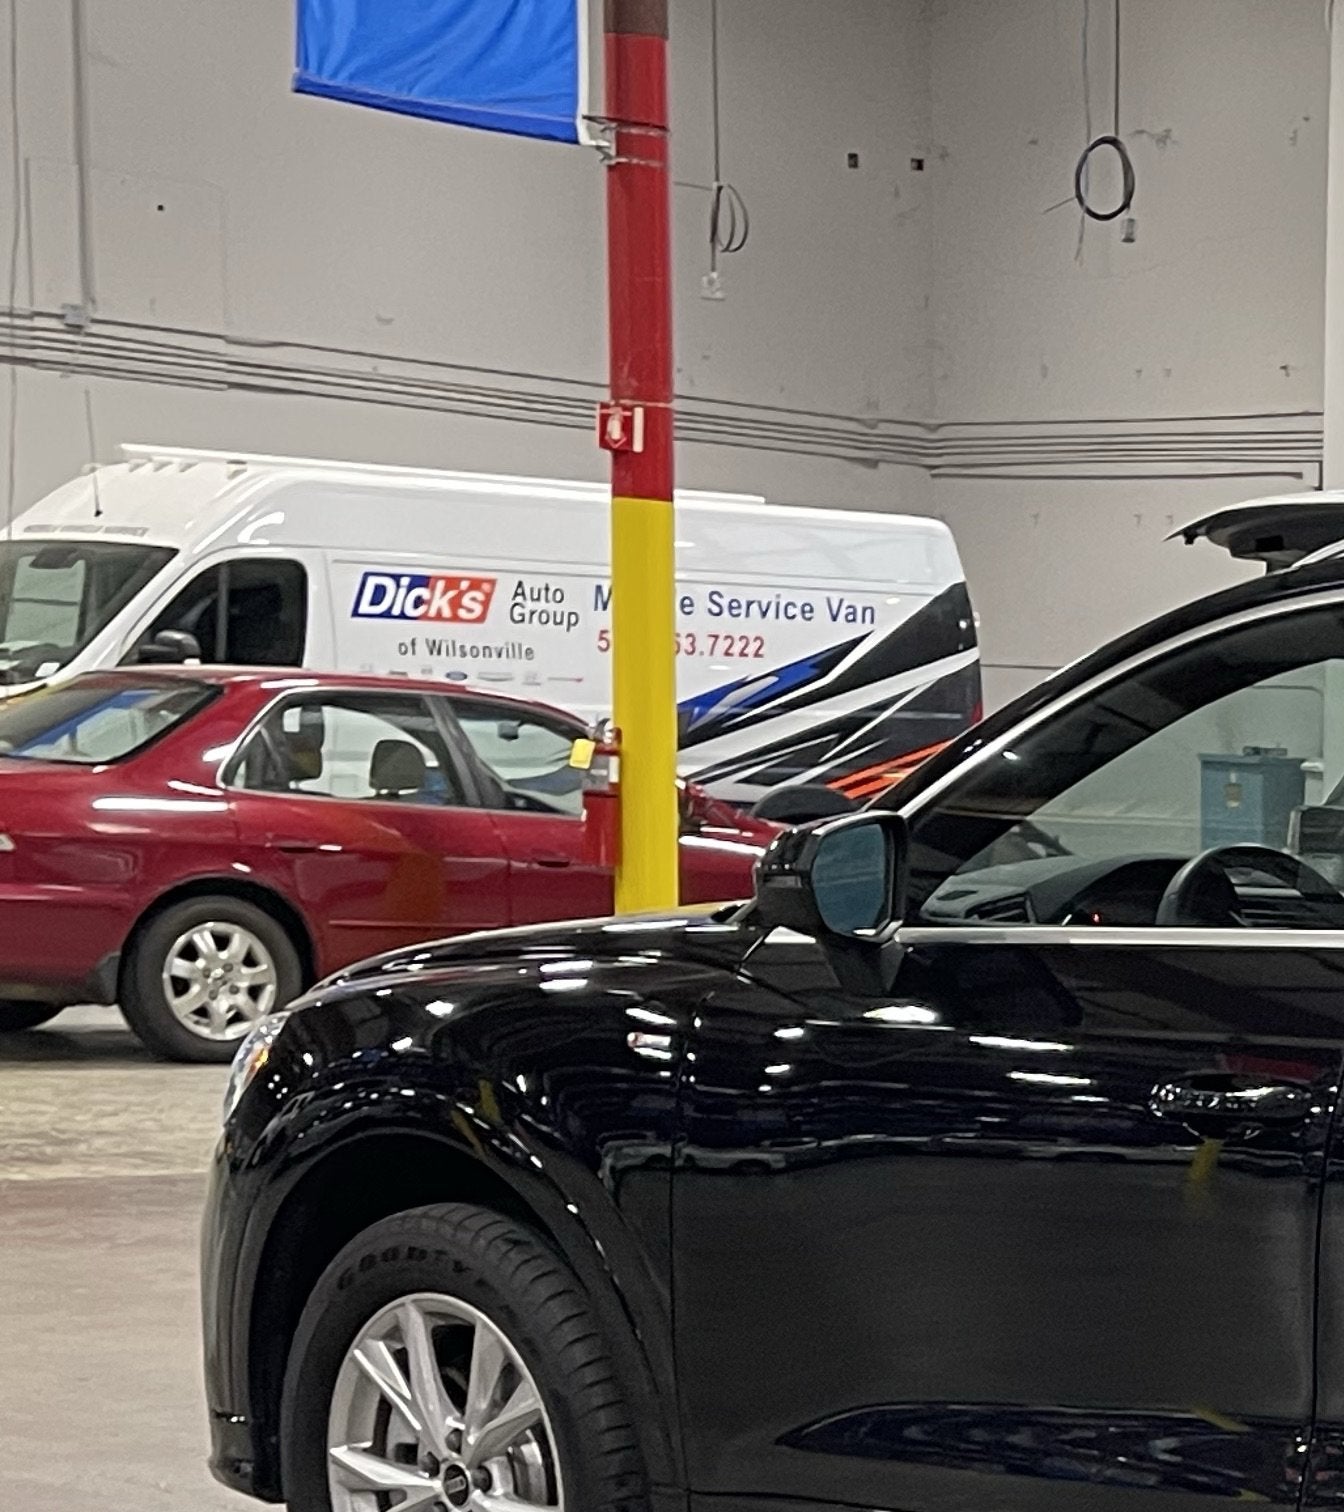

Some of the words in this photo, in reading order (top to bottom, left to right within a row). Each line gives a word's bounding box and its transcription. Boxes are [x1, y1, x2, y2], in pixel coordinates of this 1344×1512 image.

[512, 580, 565, 604] Auto
[509, 602, 579, 632] Group
[707, 590, 815, 621] Service
[826, 597, 876, 625] Van
[398, 638, 417, 656] of
[425, 638, 535, 660] Wilsonville
